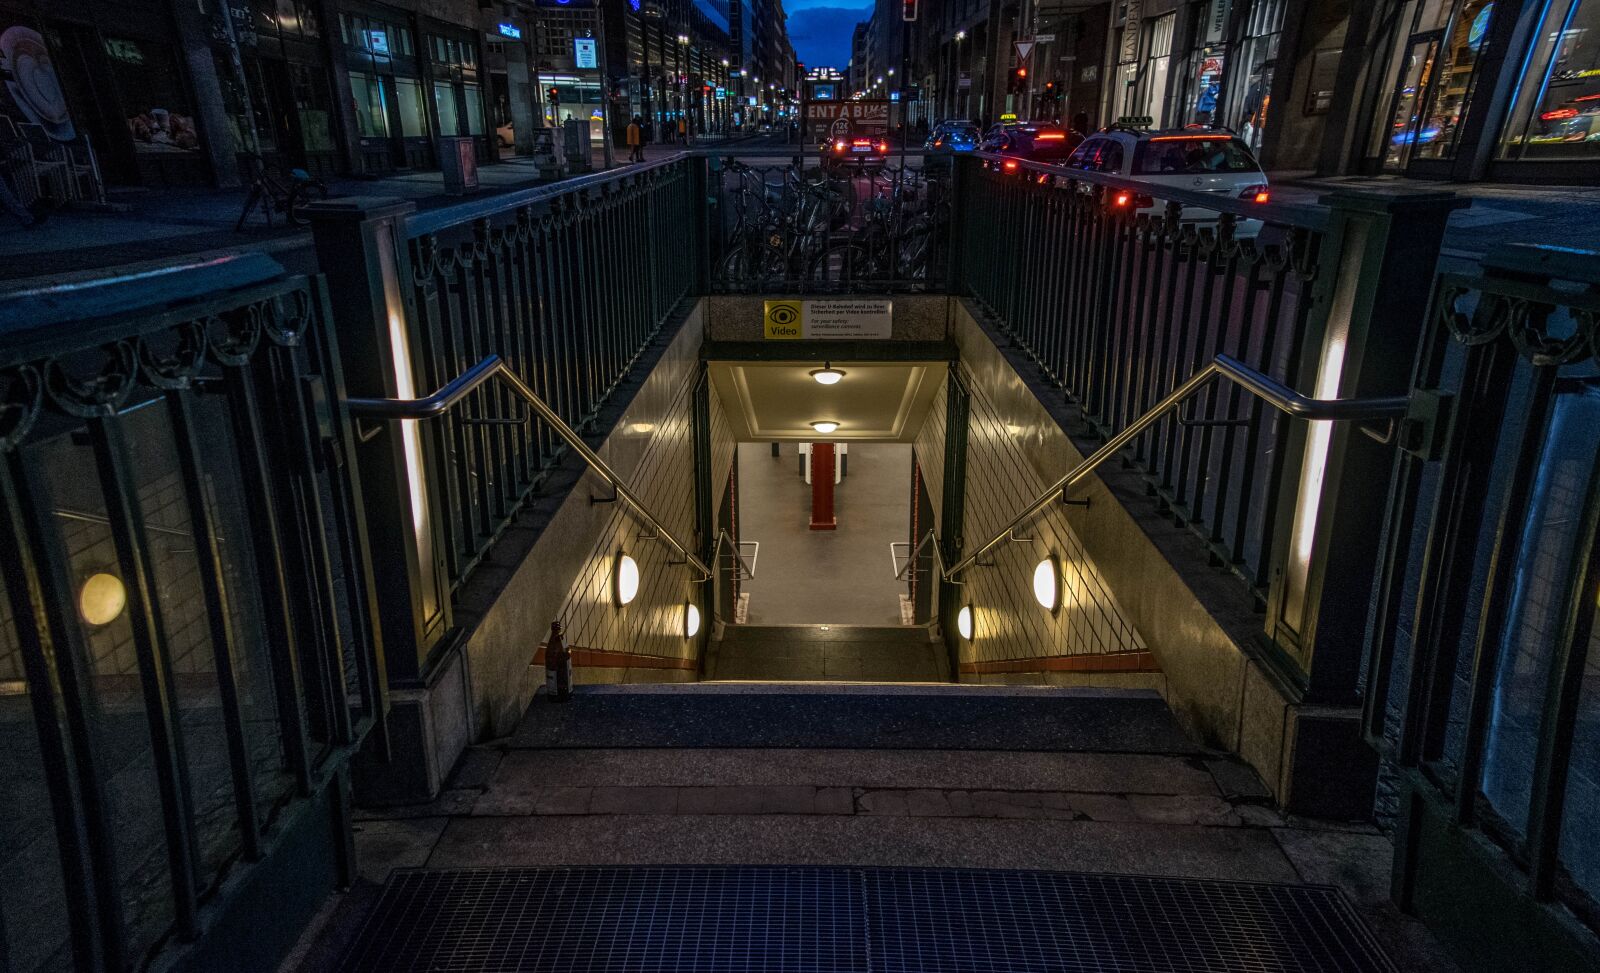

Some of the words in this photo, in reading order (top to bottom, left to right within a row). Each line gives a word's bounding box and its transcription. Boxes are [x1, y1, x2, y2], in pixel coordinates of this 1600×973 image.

[1124, 1, 1140, 56] TANDEM
[808, 105, 837, 118] ENT
[840, 105, 850, 118] A
[771, 326, 797, 336] Video
